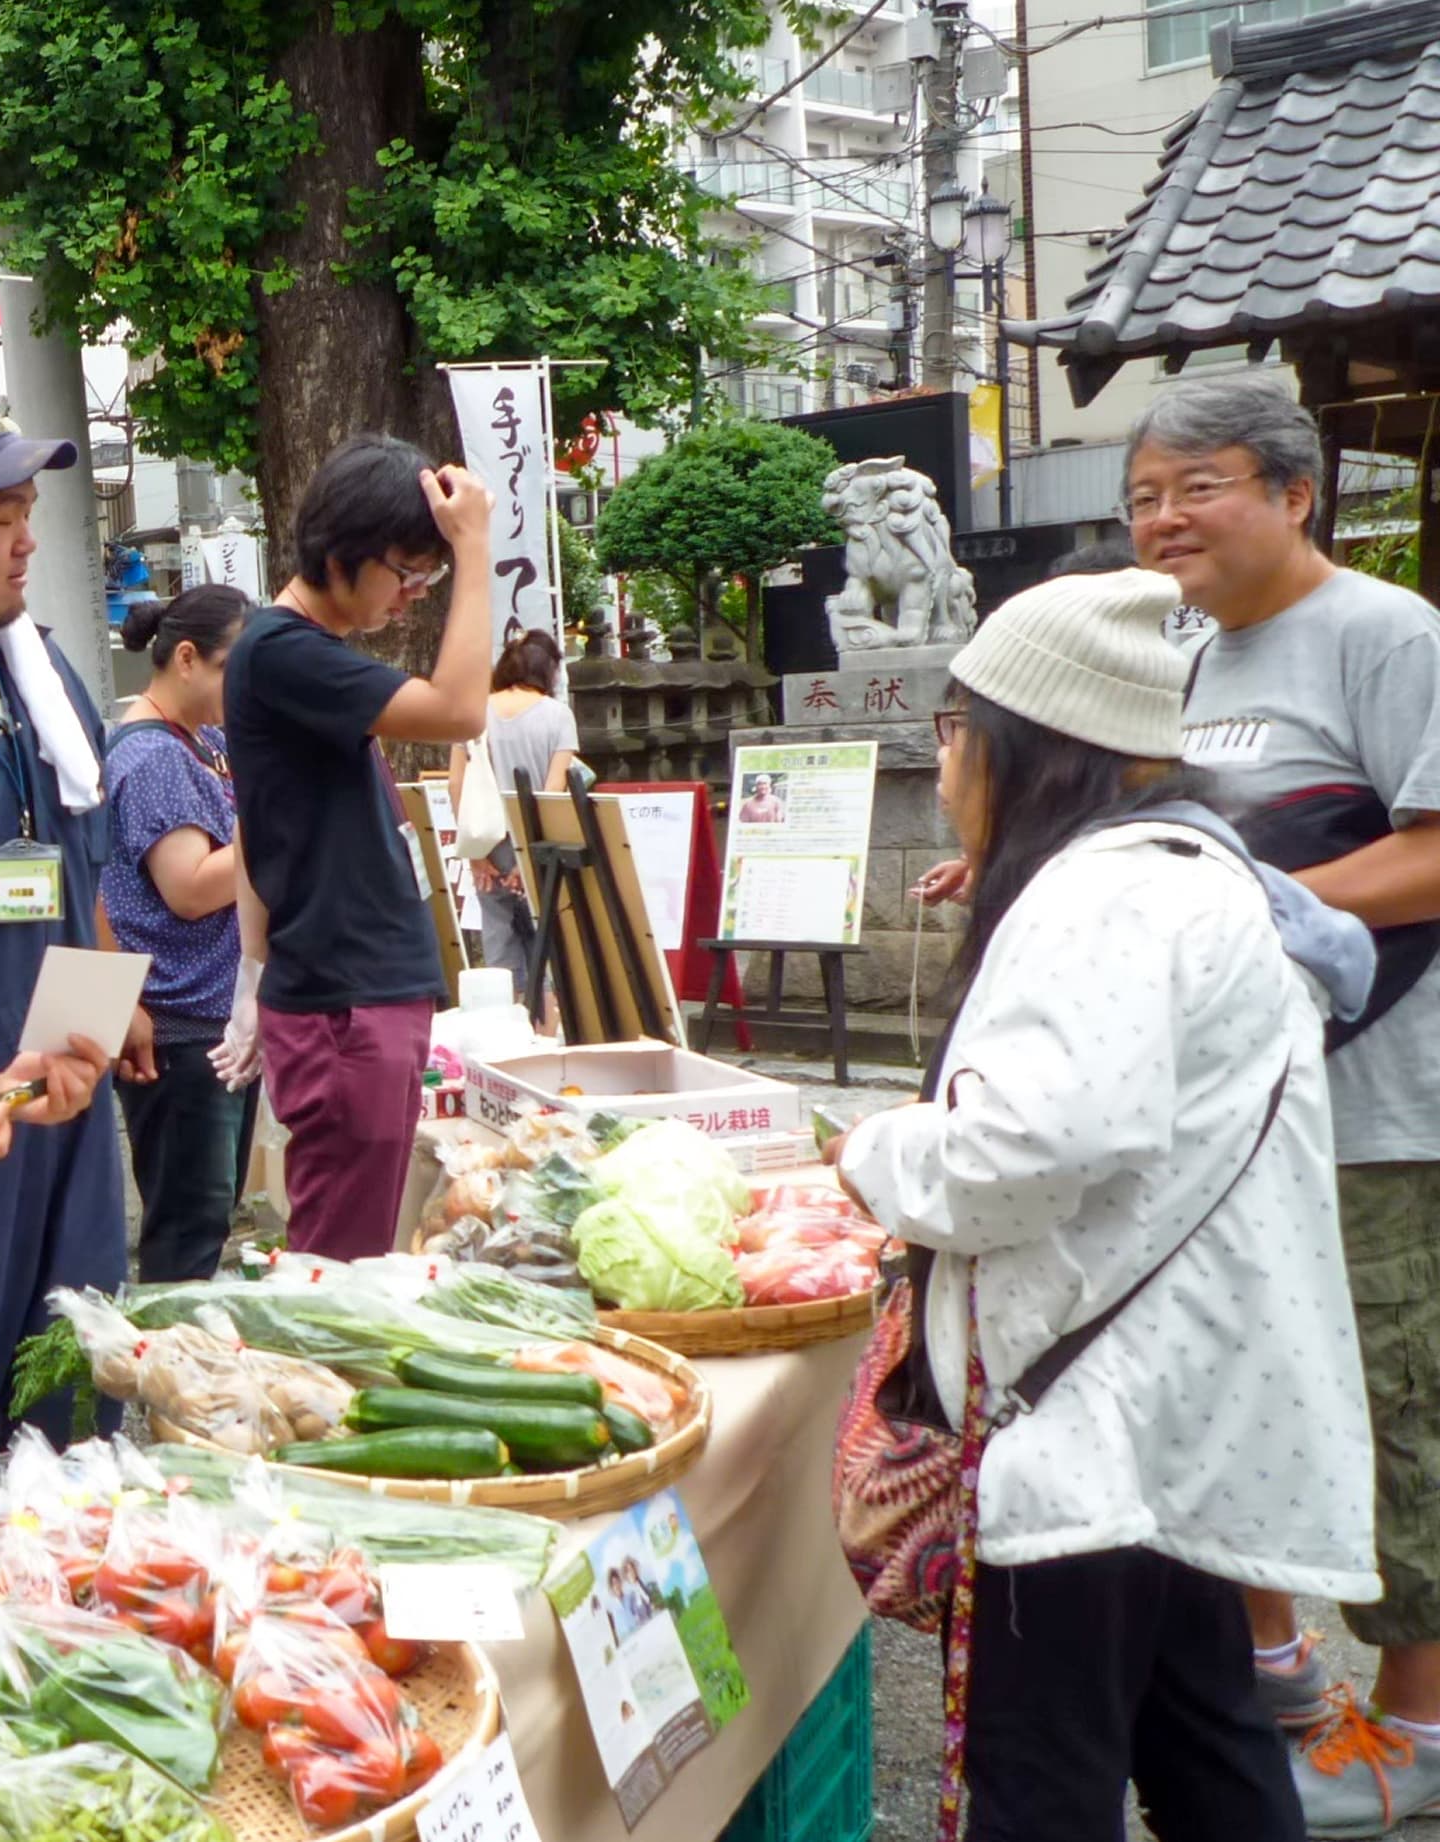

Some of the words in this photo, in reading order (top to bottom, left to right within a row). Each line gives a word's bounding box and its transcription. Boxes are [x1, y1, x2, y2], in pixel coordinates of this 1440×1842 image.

[803, 677, 910, 713] 奉献
[673, 1106, 771, 1133] ラル栽培
